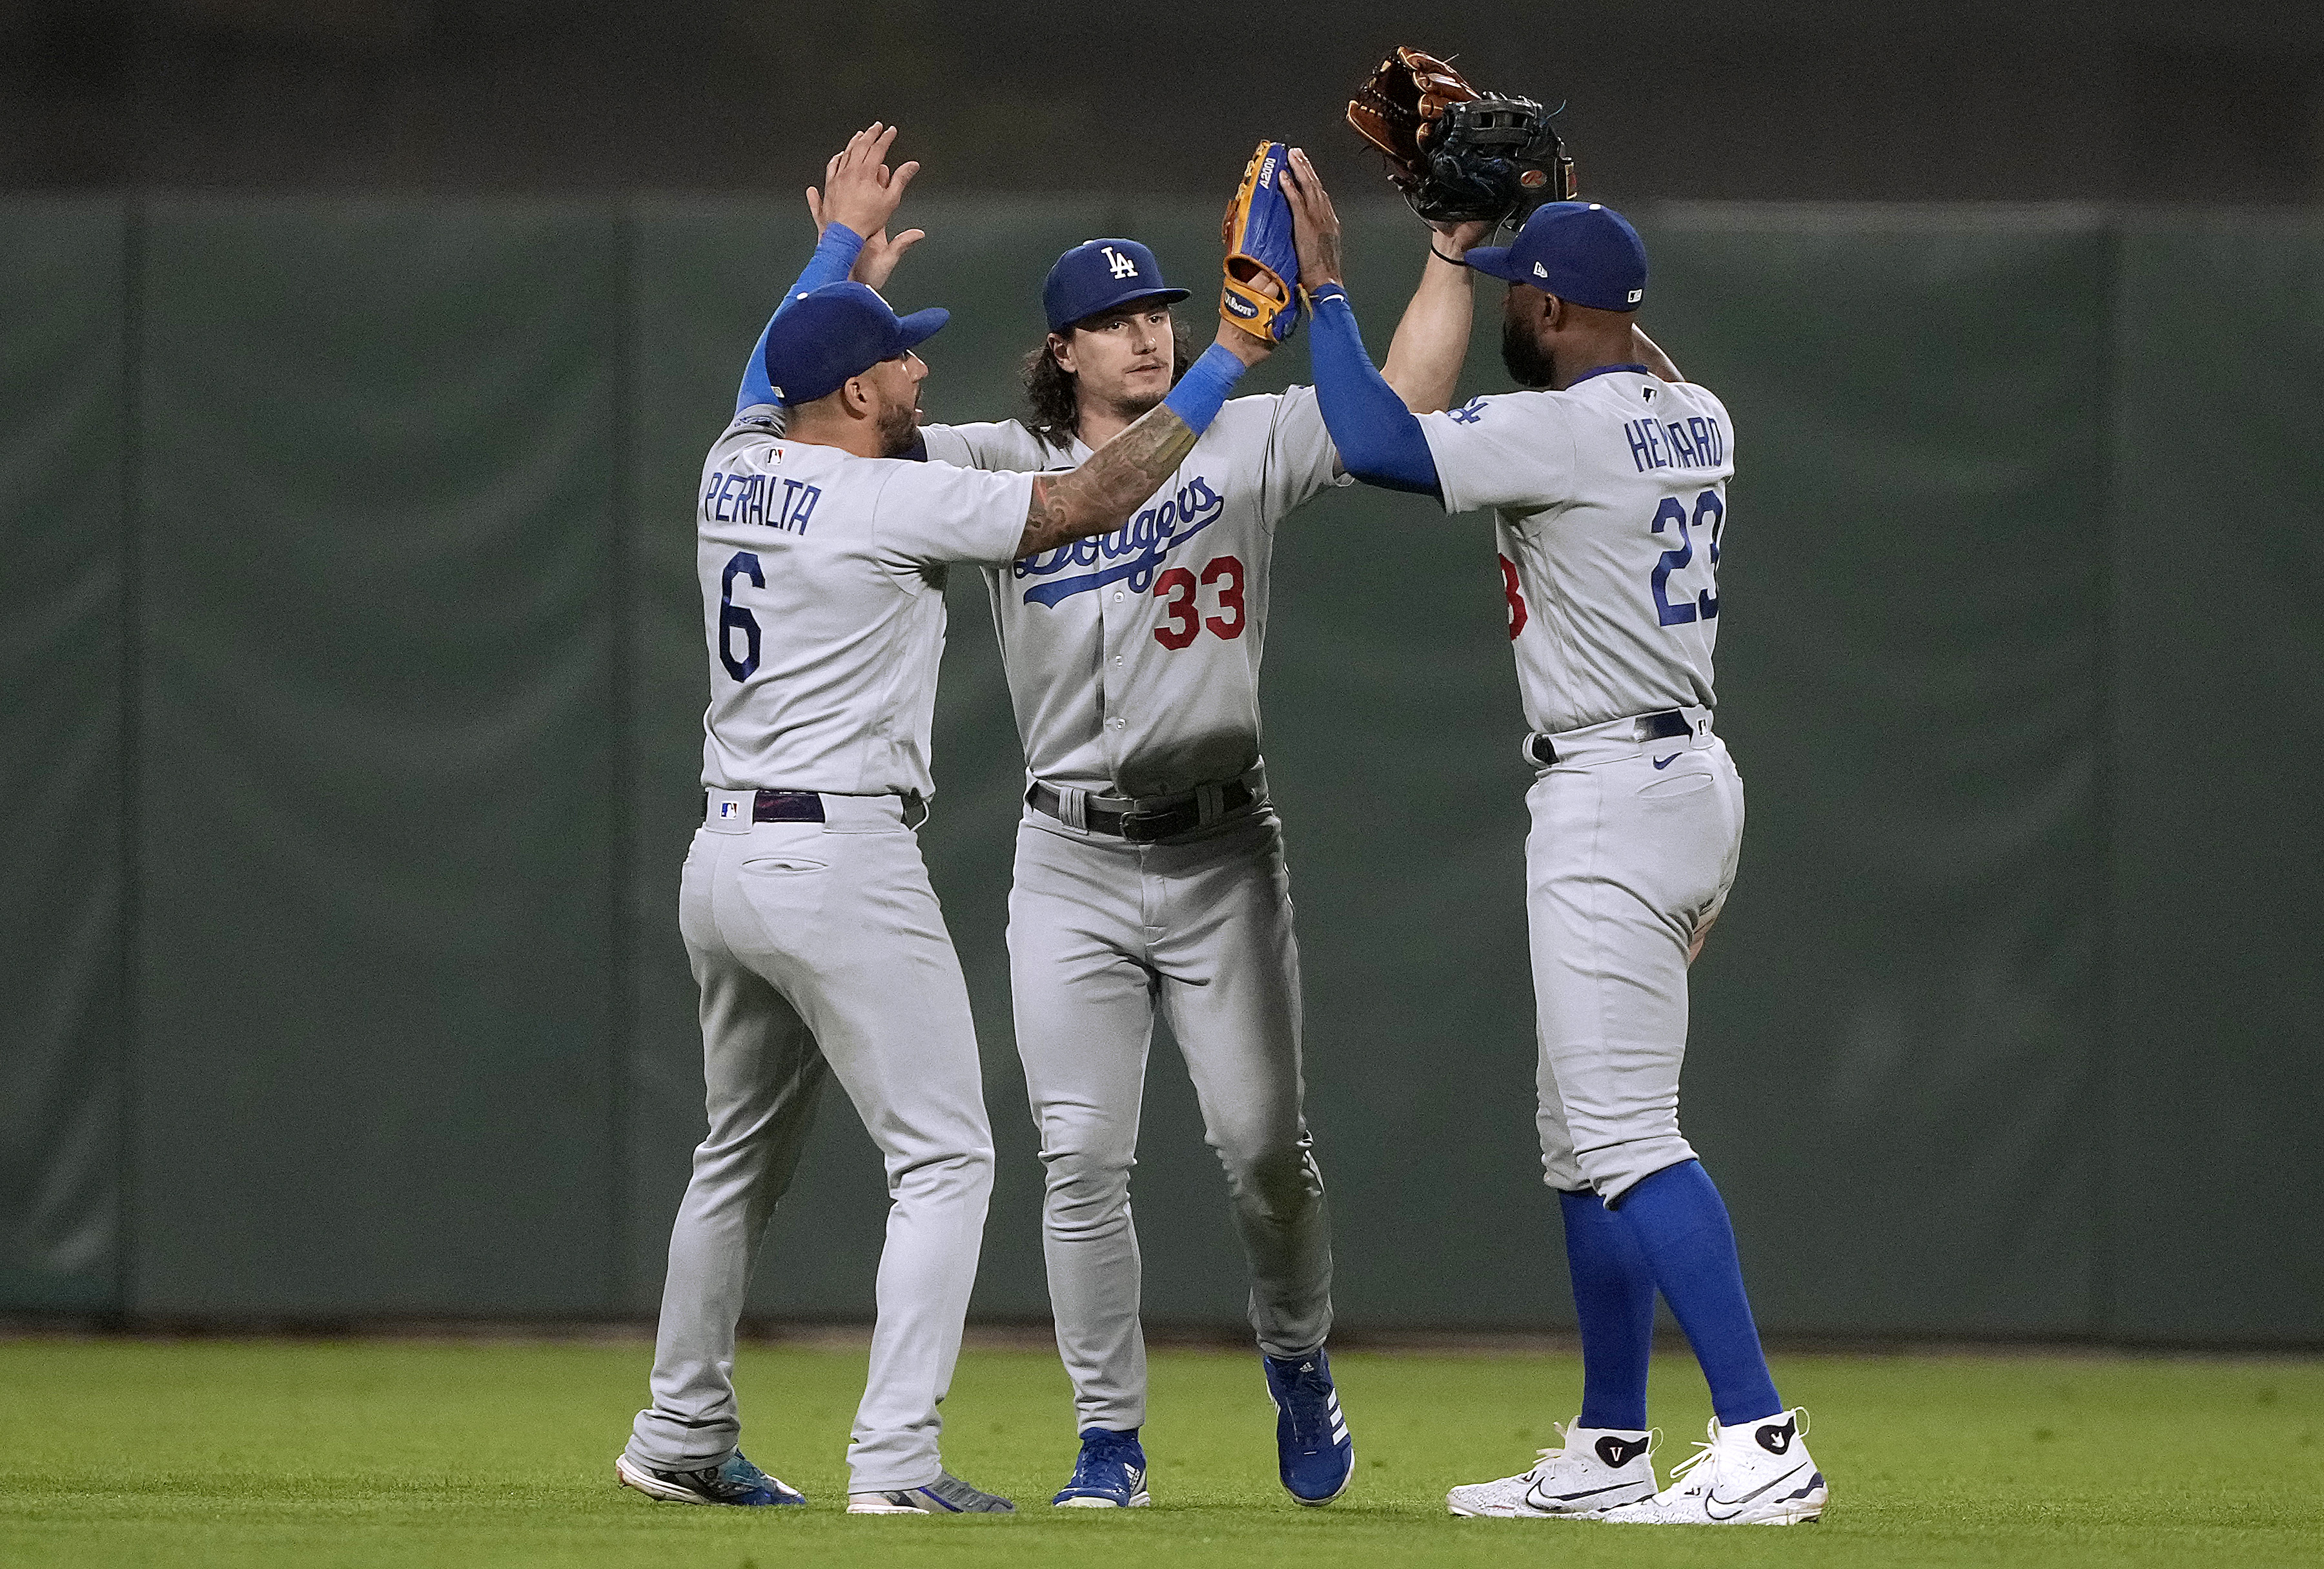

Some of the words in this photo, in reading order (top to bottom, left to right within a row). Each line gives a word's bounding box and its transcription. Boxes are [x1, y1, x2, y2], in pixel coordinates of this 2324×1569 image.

[1259, 158, 1276, 189] A2000
[1101, 247, 1138, 279] LA
[1624, 417, 1723, 473] HEARD
[705, 473, 822, 535] PERALTA
[1651, 490, 1720, 626] 23
[719, 551, 766, 683] 6
[1153, 555, 1245, 650] 33
[1609, 1447, 1623, 1462] V
